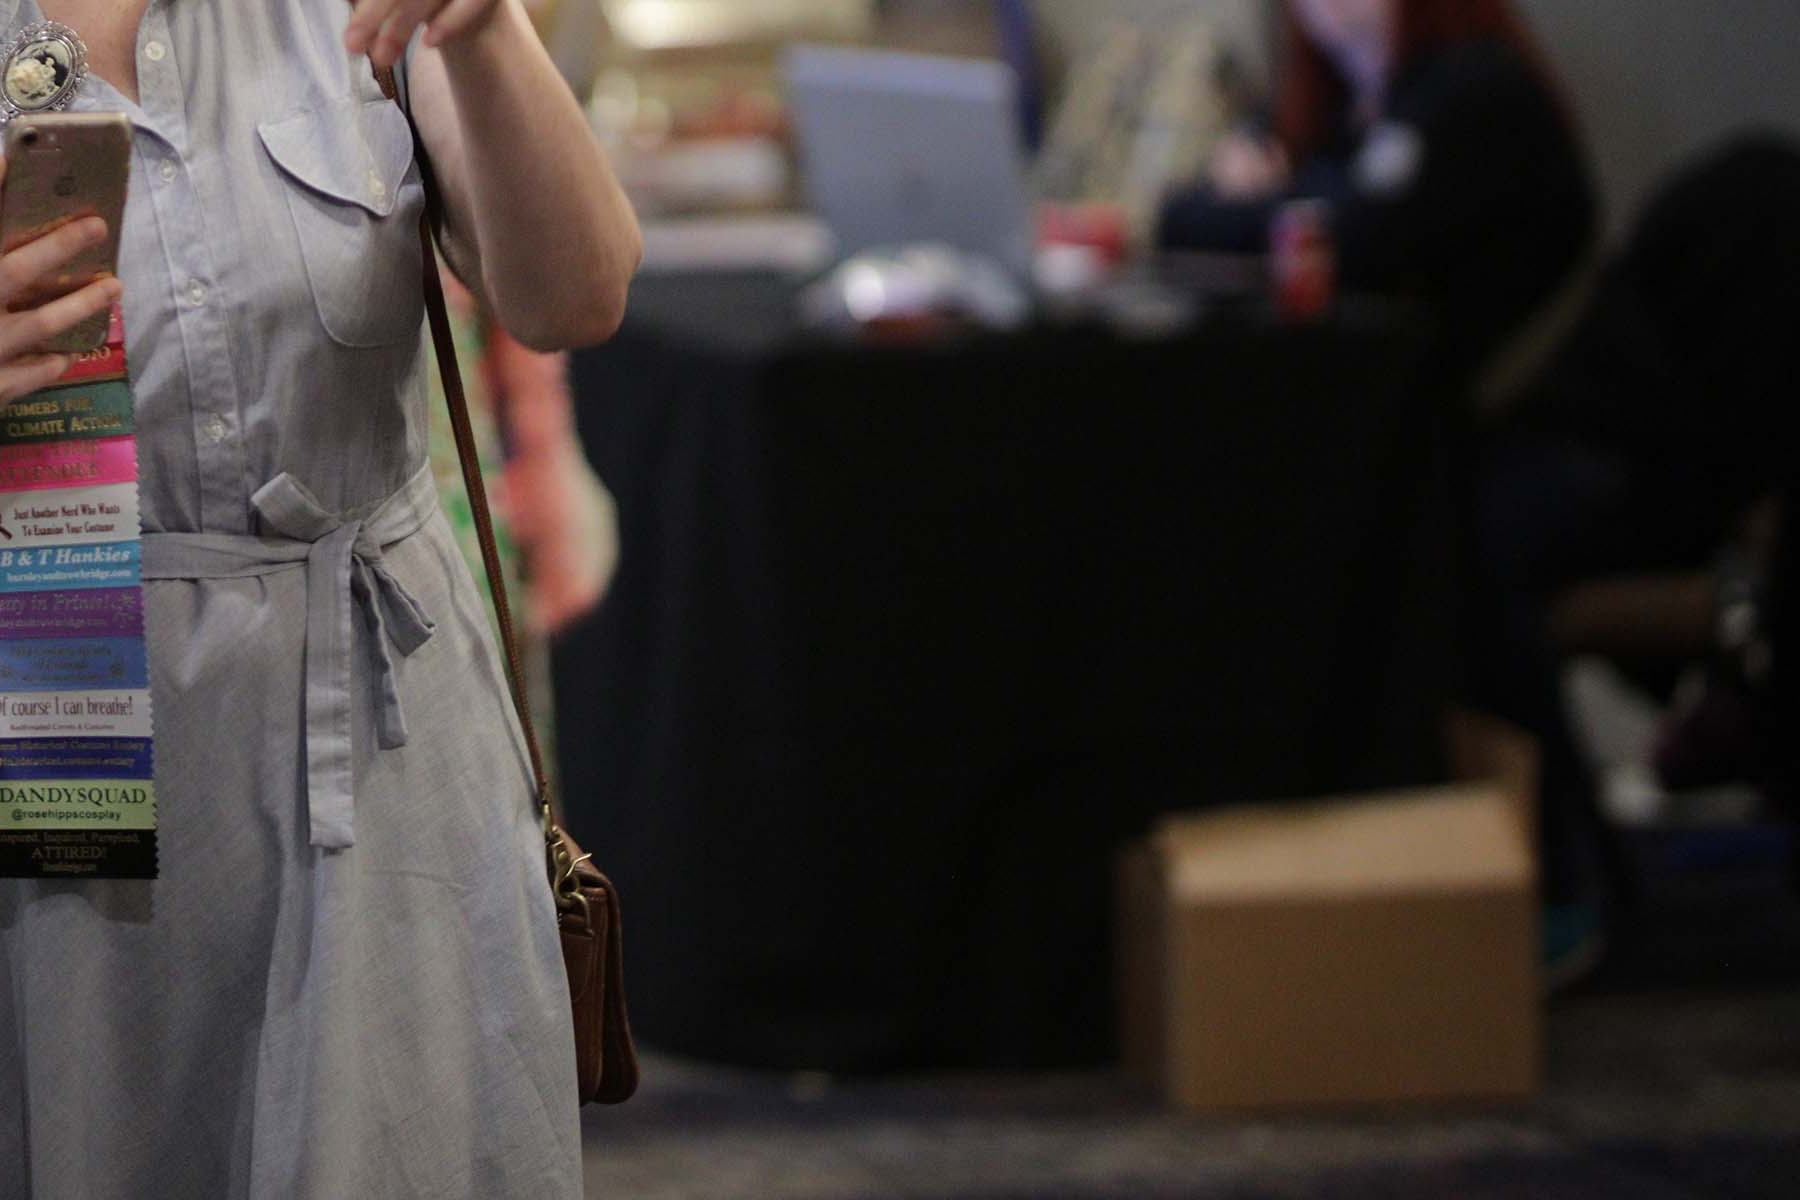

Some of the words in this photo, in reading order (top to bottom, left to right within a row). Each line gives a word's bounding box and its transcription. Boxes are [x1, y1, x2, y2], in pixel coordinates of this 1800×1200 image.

[8, 420, 66, 437] CLIMATE
[0, 551, 14, 567] B
[17, 551, 32, 566] &
[38, 549, 52, 565] T
[55, 546, 131, 564] Hankies
[11, 699, 51, 715] course
[55, 696, 60, 715] I
[63, 700, 84, 715] can
[87, 696, 133, 715] breathe!
[11, 809, 121, 821] @rosehippscosplay
